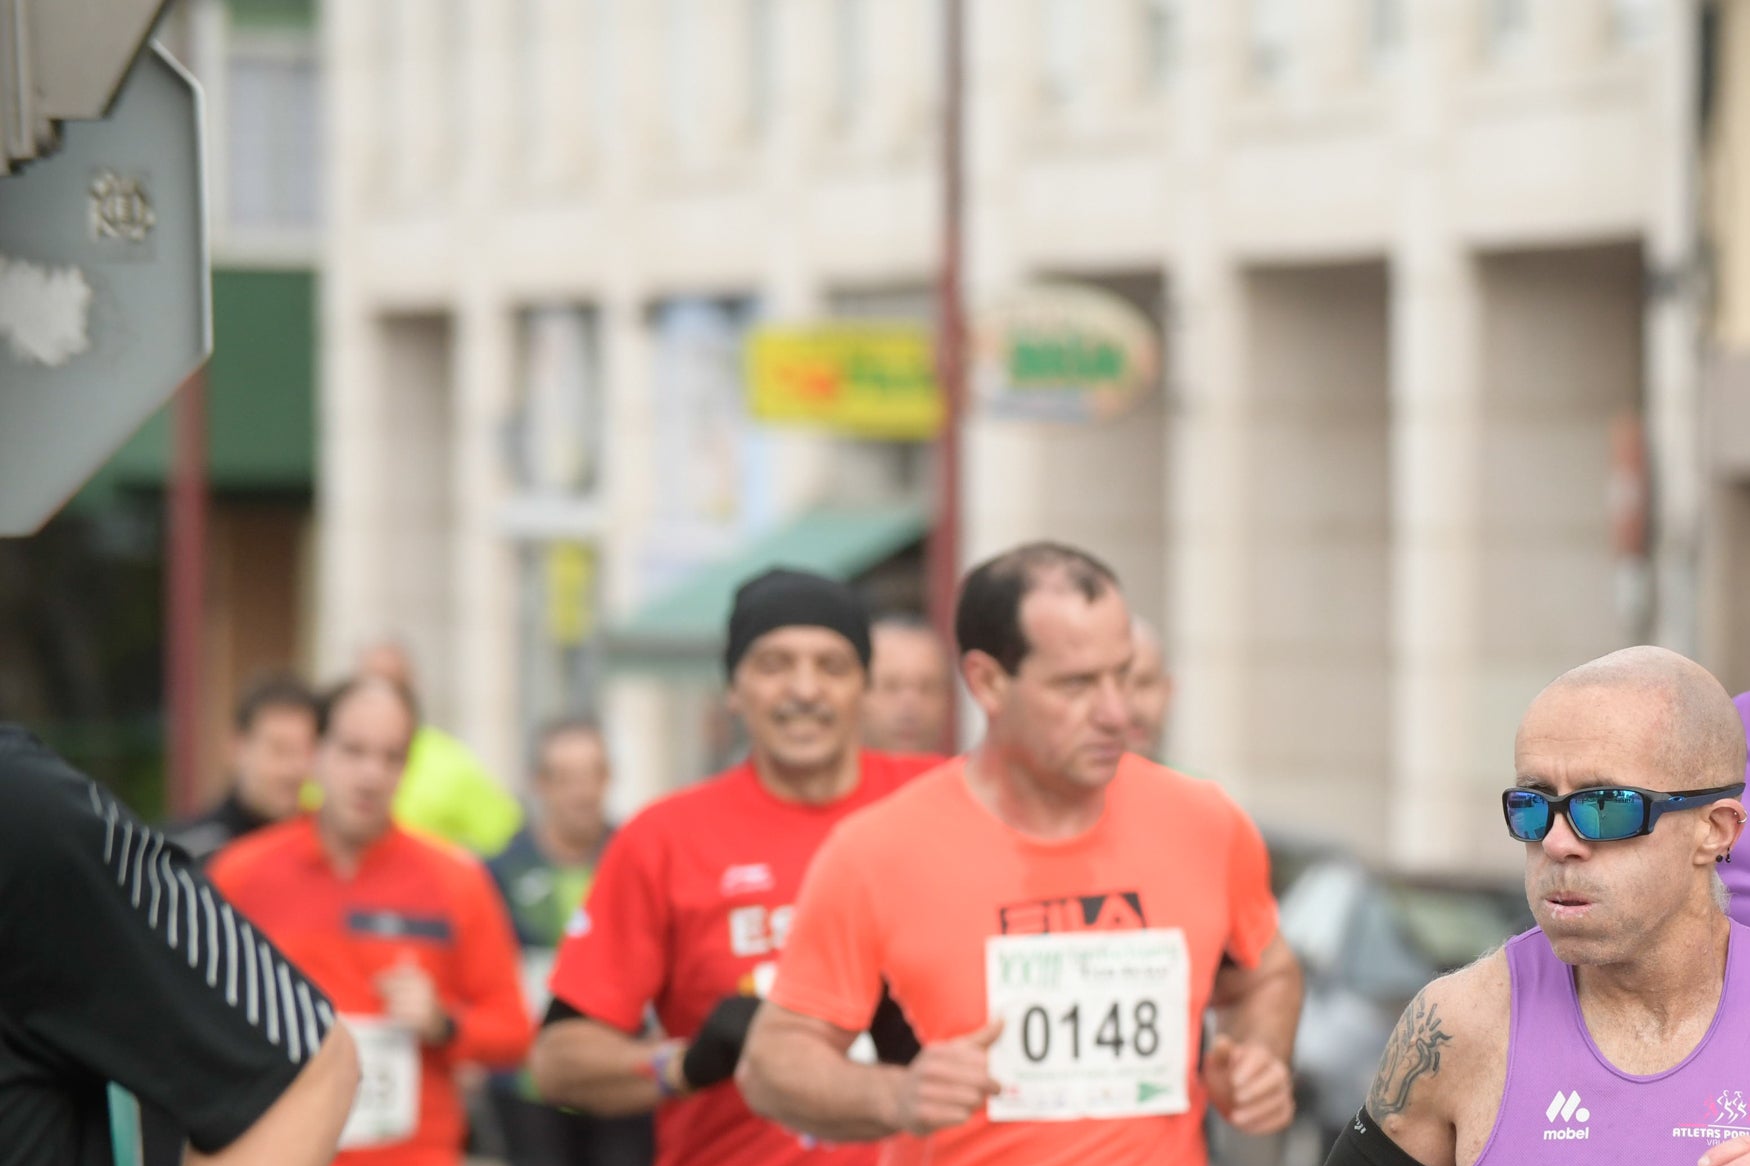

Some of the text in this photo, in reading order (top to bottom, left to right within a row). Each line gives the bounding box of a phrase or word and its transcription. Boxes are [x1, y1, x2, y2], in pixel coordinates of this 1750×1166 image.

[1022, 1000, 1159, 1063] 0148
[1543, 1126, 1590, 1141] mobel
[1673, 1128, 1721, 1138] ATLETAS
